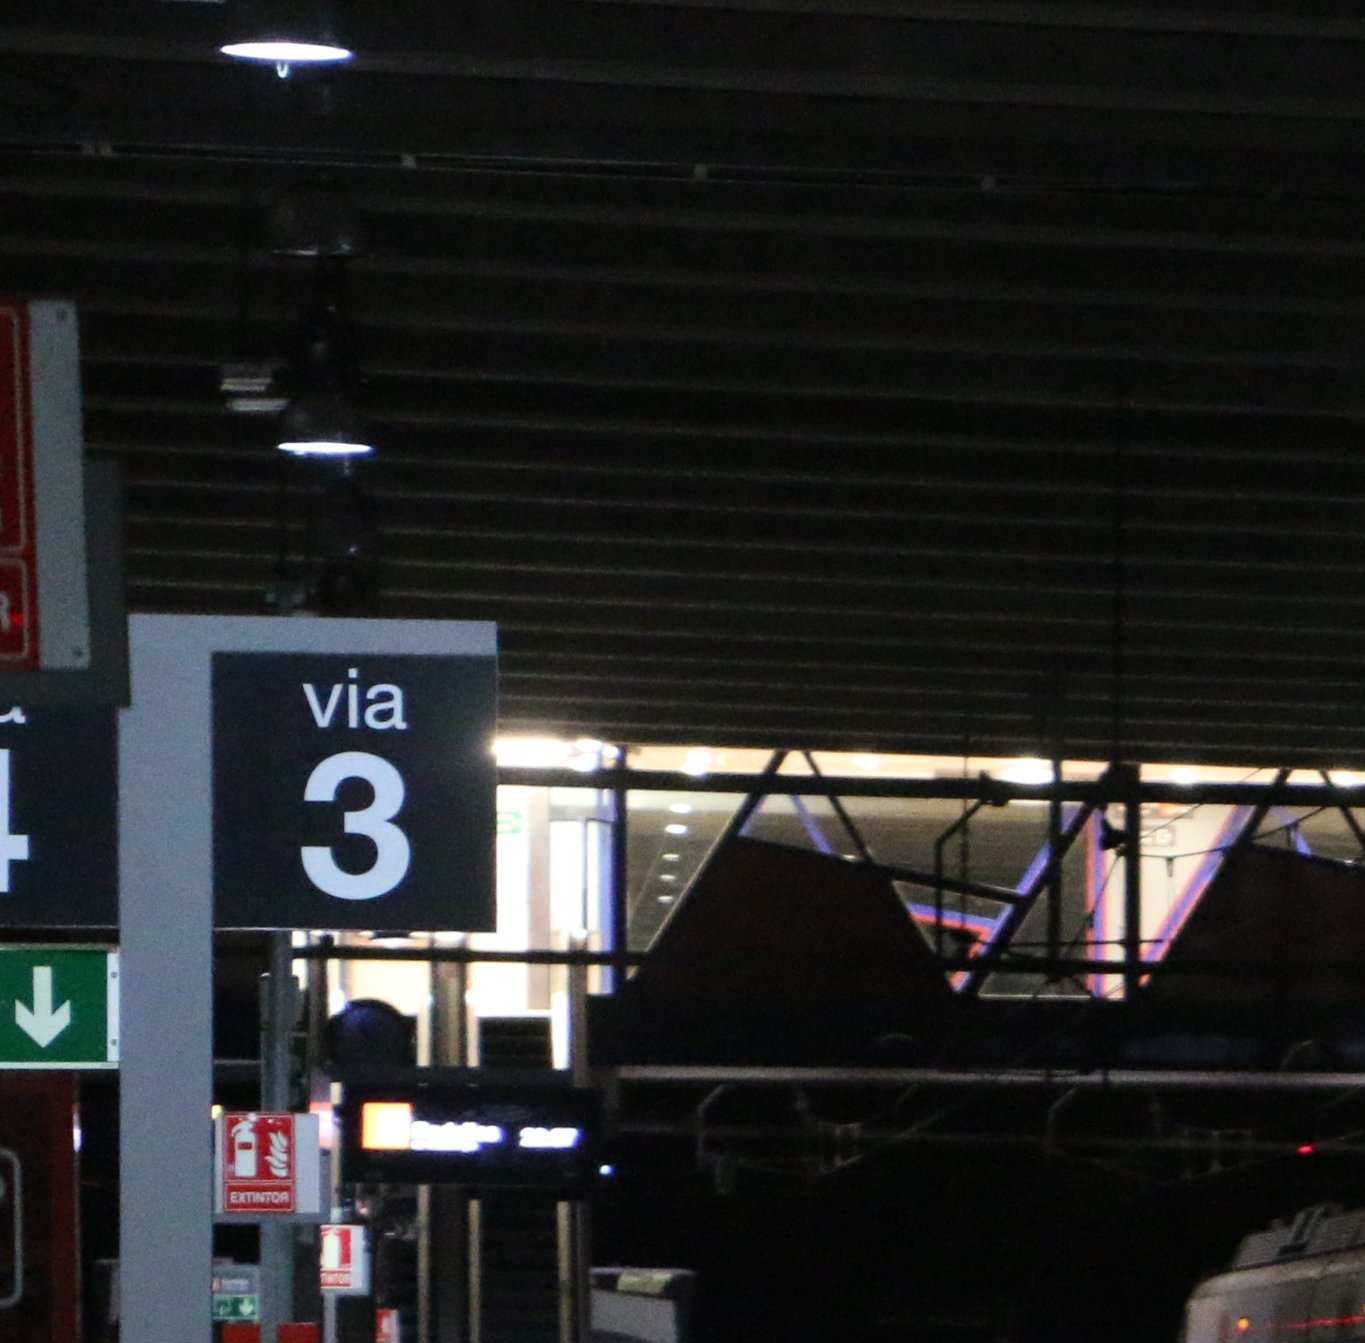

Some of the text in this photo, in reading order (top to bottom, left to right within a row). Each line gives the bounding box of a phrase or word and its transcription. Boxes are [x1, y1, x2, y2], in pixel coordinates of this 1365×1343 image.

[303, 667, 408, 731] via
[300, 751, 411, 901] 3
[229, 1190, 290, 1204] EXTINTOR
